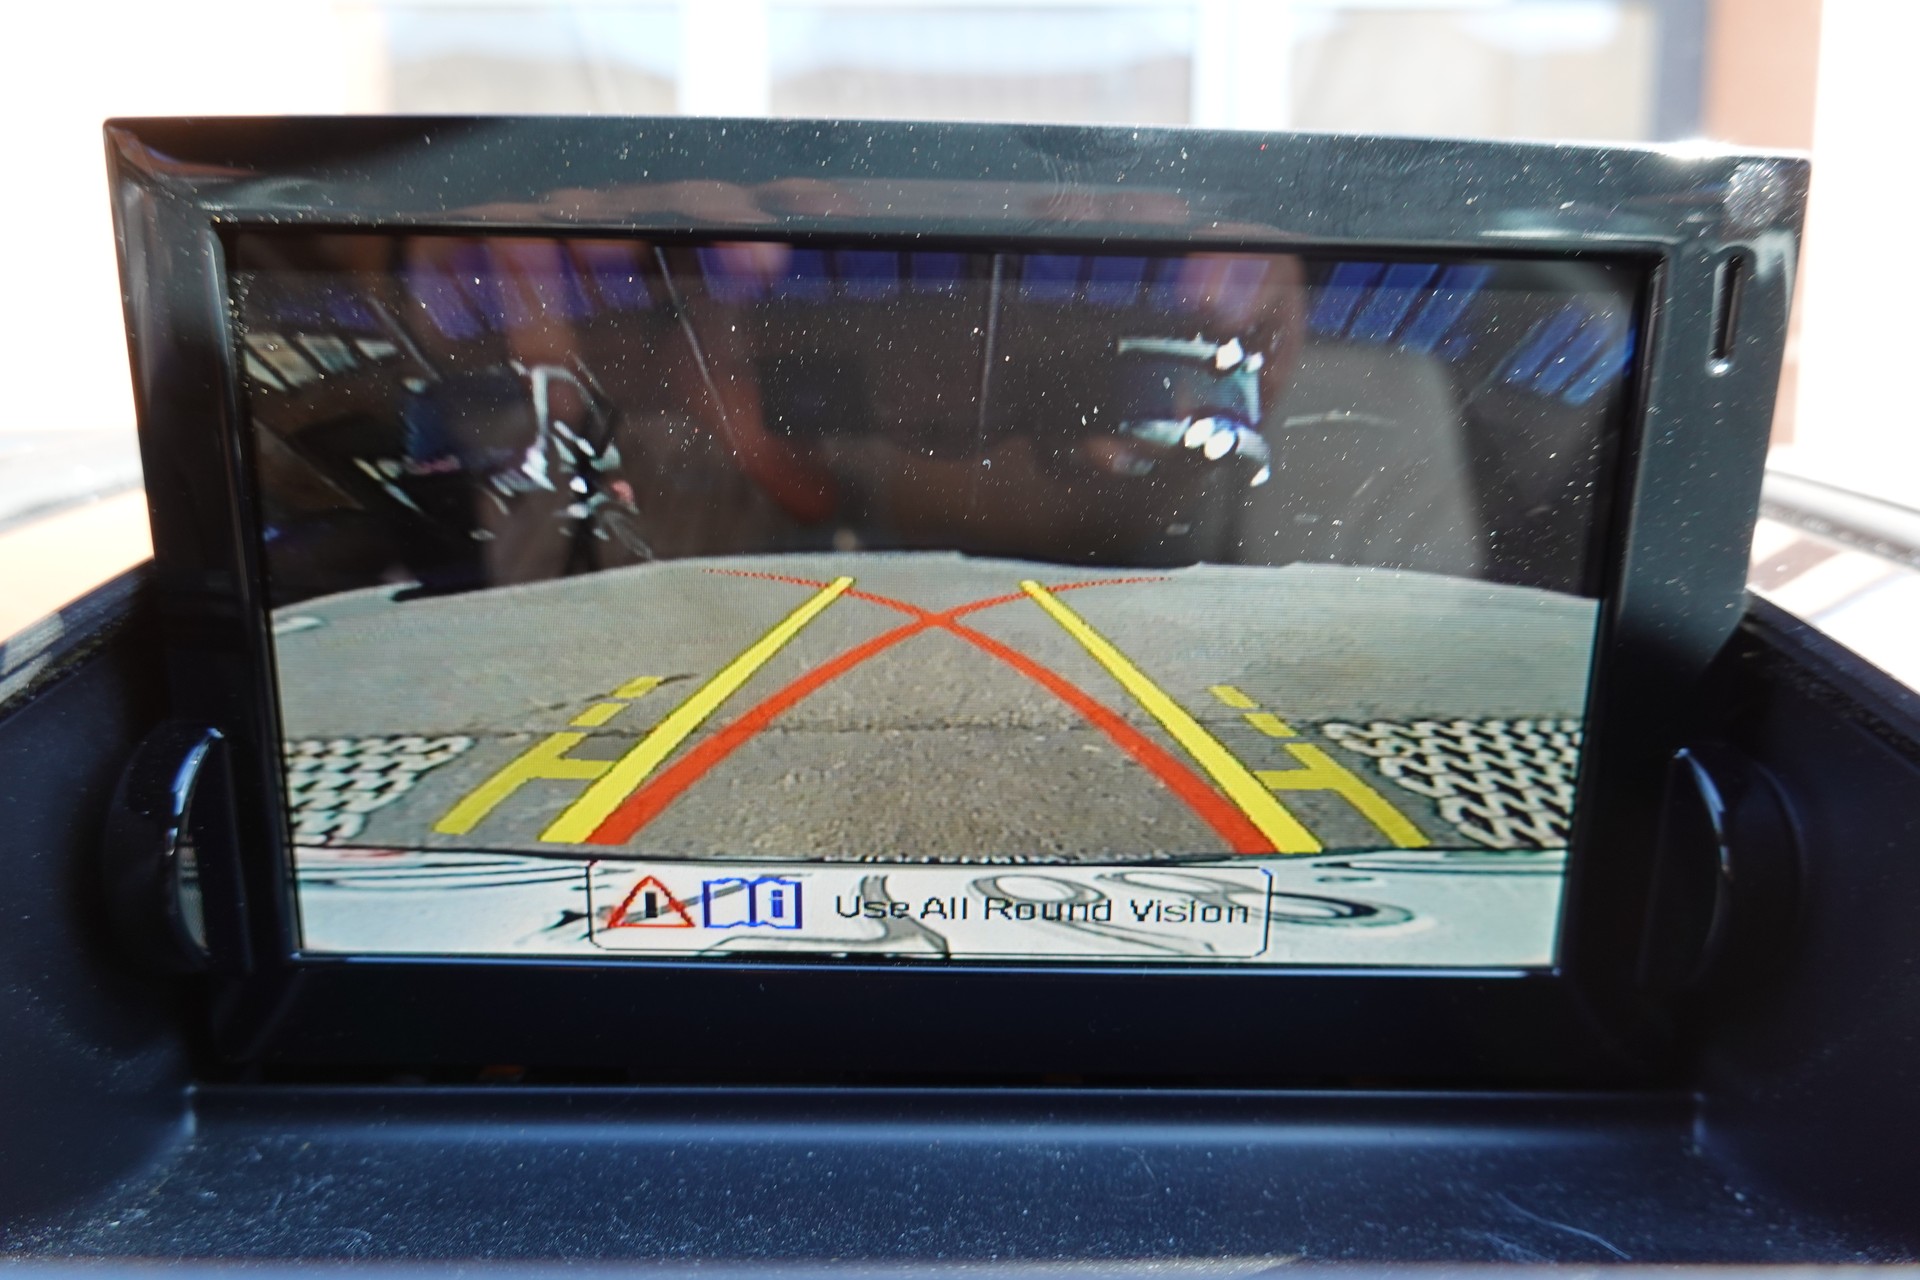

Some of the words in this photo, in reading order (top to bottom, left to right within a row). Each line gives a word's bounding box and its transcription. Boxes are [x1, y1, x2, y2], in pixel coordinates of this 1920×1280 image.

[836, 895, 909, 919] Use
[920, 896, 968, 920] All
[984, 898, 1112, 922] Round
[1130, 899, 1249, 924] Vision
